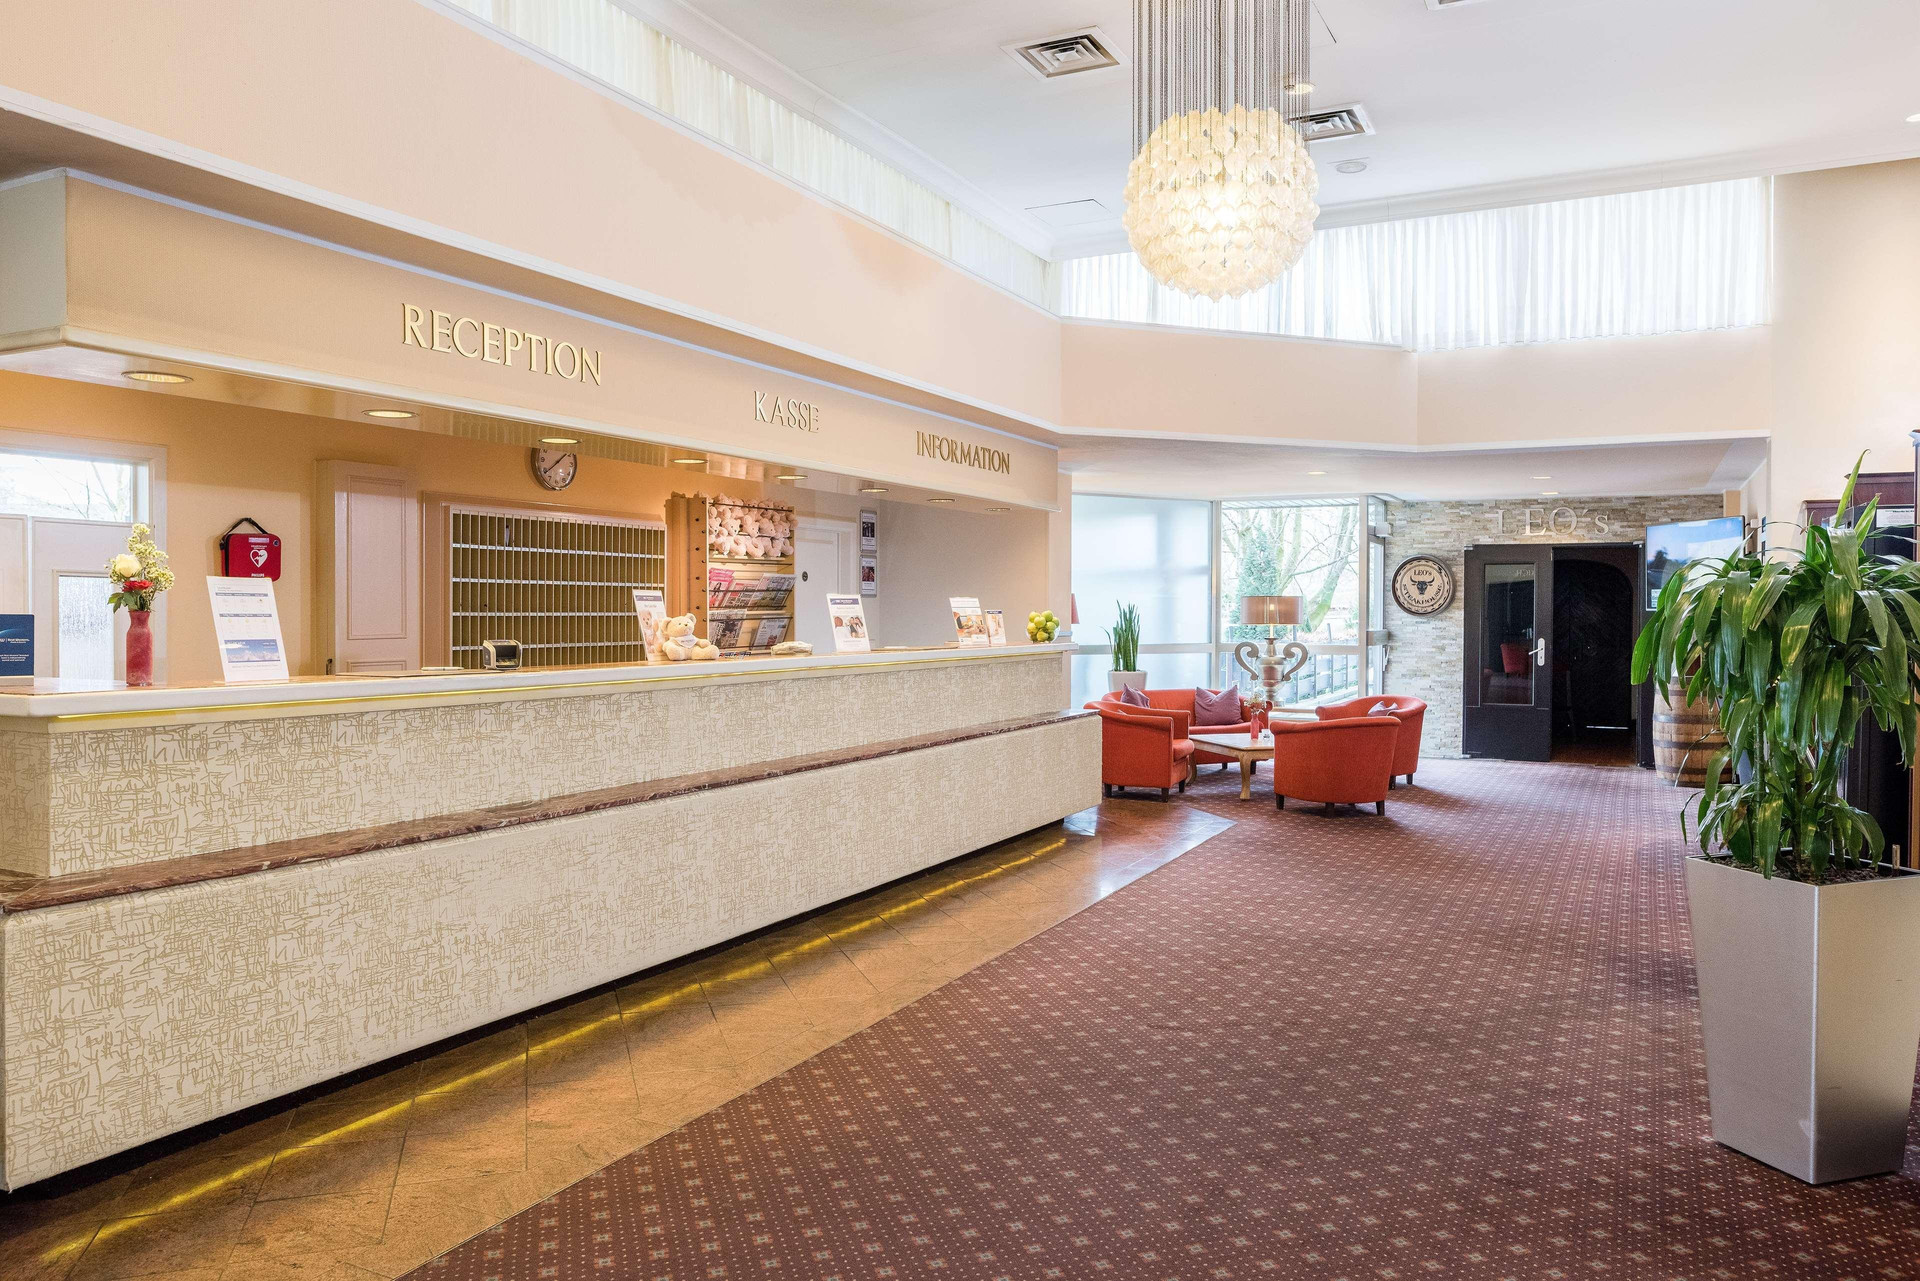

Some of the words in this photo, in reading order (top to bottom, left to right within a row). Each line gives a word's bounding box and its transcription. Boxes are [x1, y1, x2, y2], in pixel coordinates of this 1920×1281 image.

[402, 303, 602, 386] RECEPTION
[754, 390, 820, 433] KASSE
[916, 431, 1011, 475] INFORMATION
